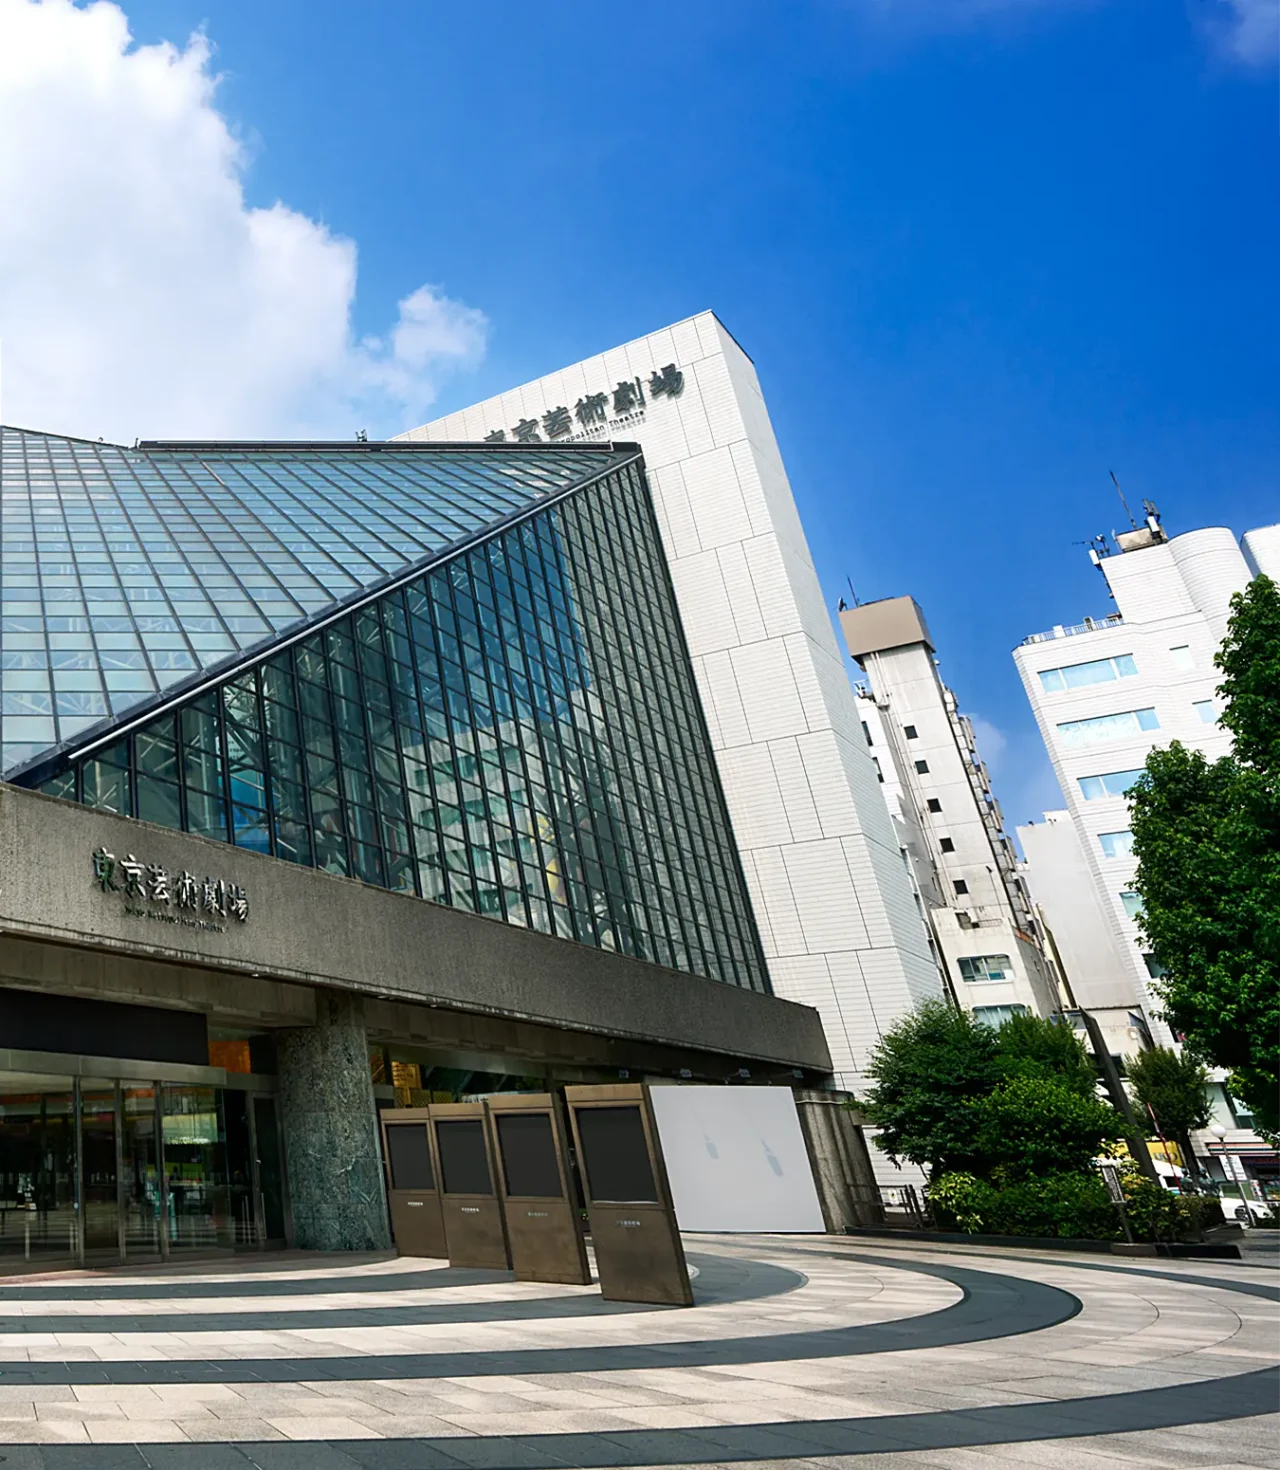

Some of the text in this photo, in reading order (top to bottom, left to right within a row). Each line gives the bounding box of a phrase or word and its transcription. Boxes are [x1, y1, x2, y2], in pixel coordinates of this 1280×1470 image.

[608, 410, 644, 427] Theatre
[92, 847, 249, 922] 東京芸術劇場
